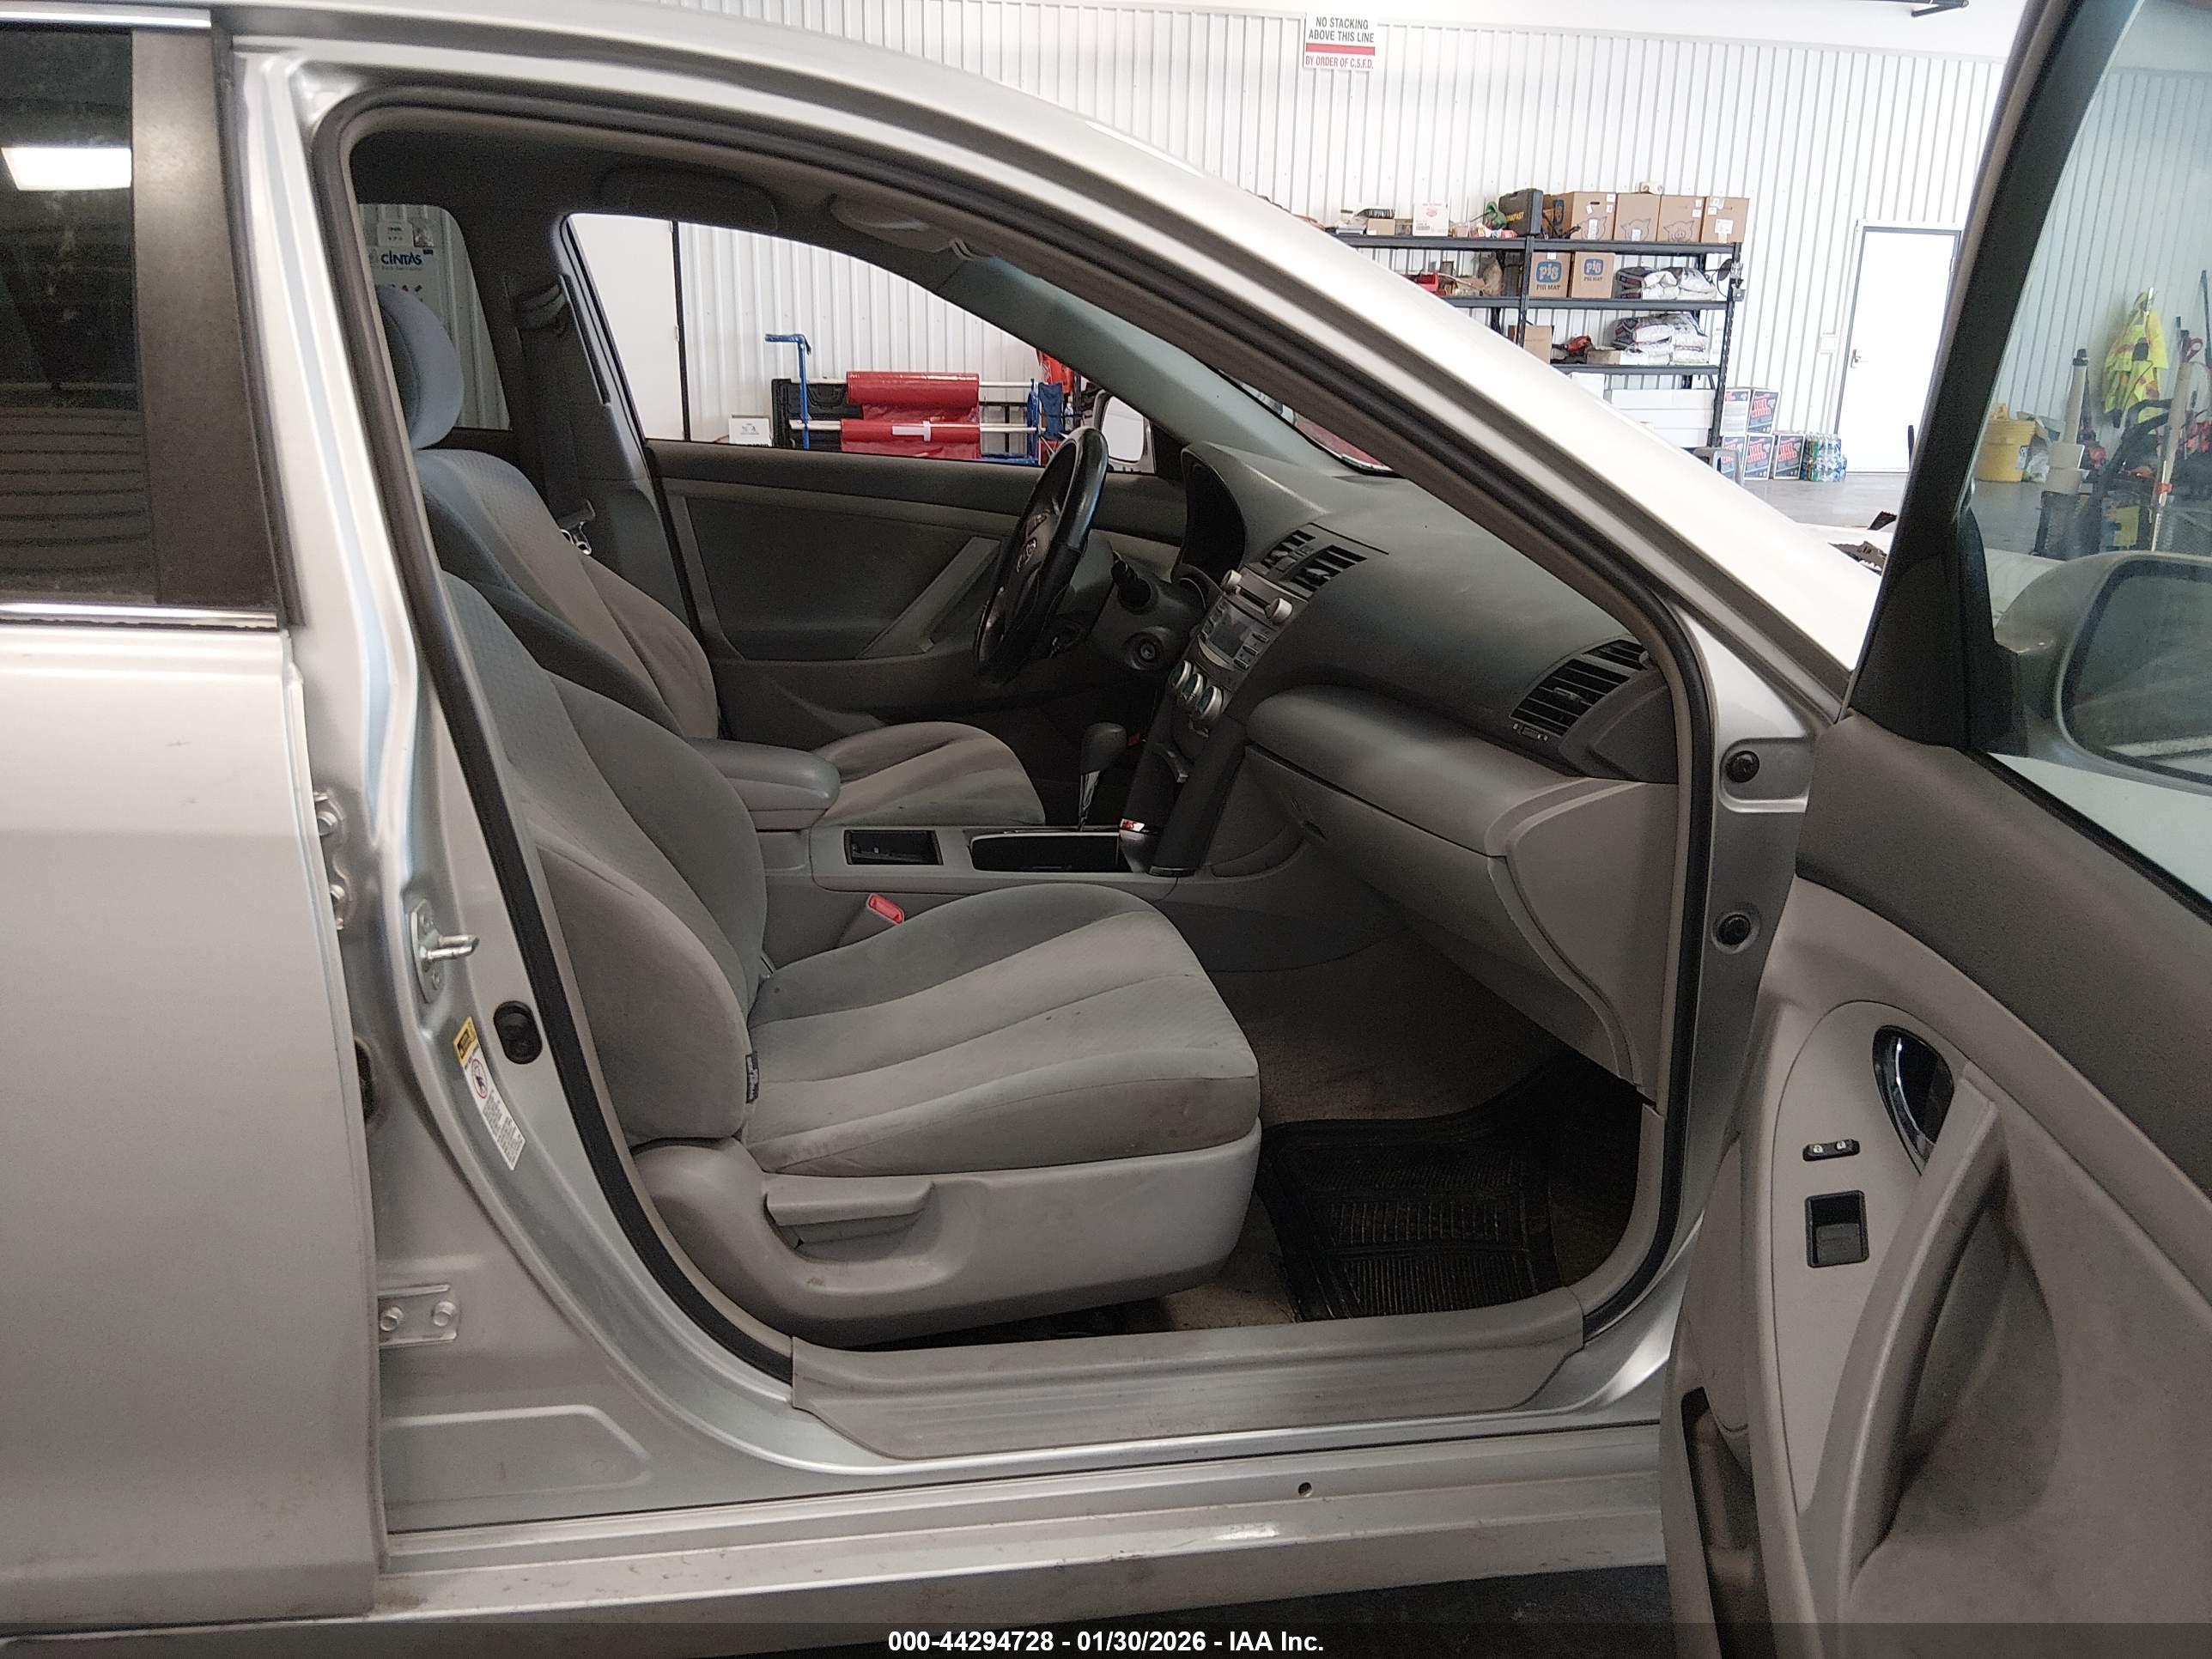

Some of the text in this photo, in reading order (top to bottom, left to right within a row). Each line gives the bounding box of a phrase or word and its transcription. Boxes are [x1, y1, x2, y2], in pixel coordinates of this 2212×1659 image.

[1316, 16, 1369, 30] NO STACKING
[1308, 28, 1375, 43] ABOVE THIS LINE
[1305, 55, 1314, 66] BY
[1316, 56, 1339, 67] ORDER
[1340, 58, 1349, 68] OF
[380, 250, 422, 265] CINTAS
